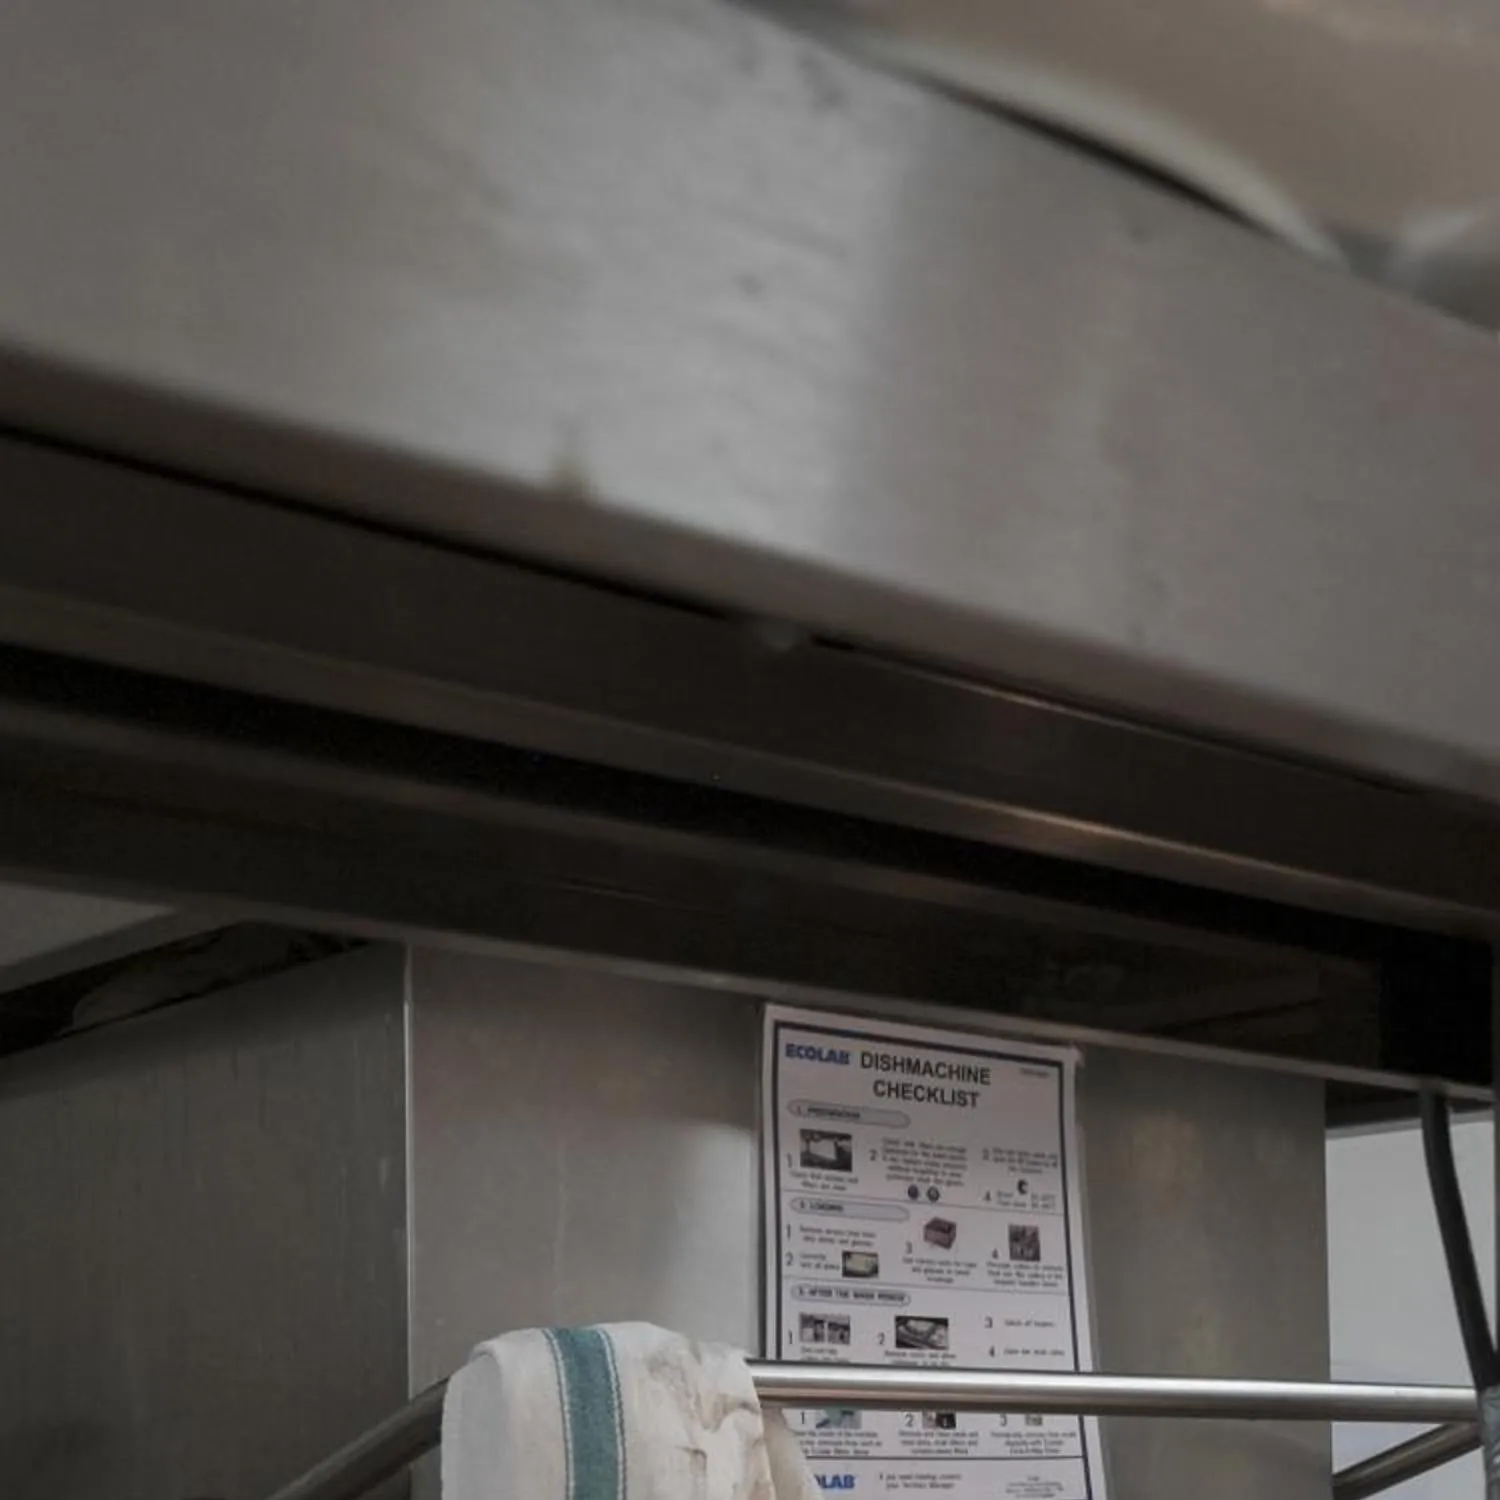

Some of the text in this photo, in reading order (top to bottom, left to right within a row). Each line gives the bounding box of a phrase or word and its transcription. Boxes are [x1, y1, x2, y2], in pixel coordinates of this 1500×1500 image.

[786, 1043, 850, 1065] ECOLAB
[860, 1052, 991, 1086] DISHMACHINE
[873, 1079, 980, 1108] CHECKLIST
[905, 1413, 914, 1427] 2
[814, 1474, 856, 1489] LAB
